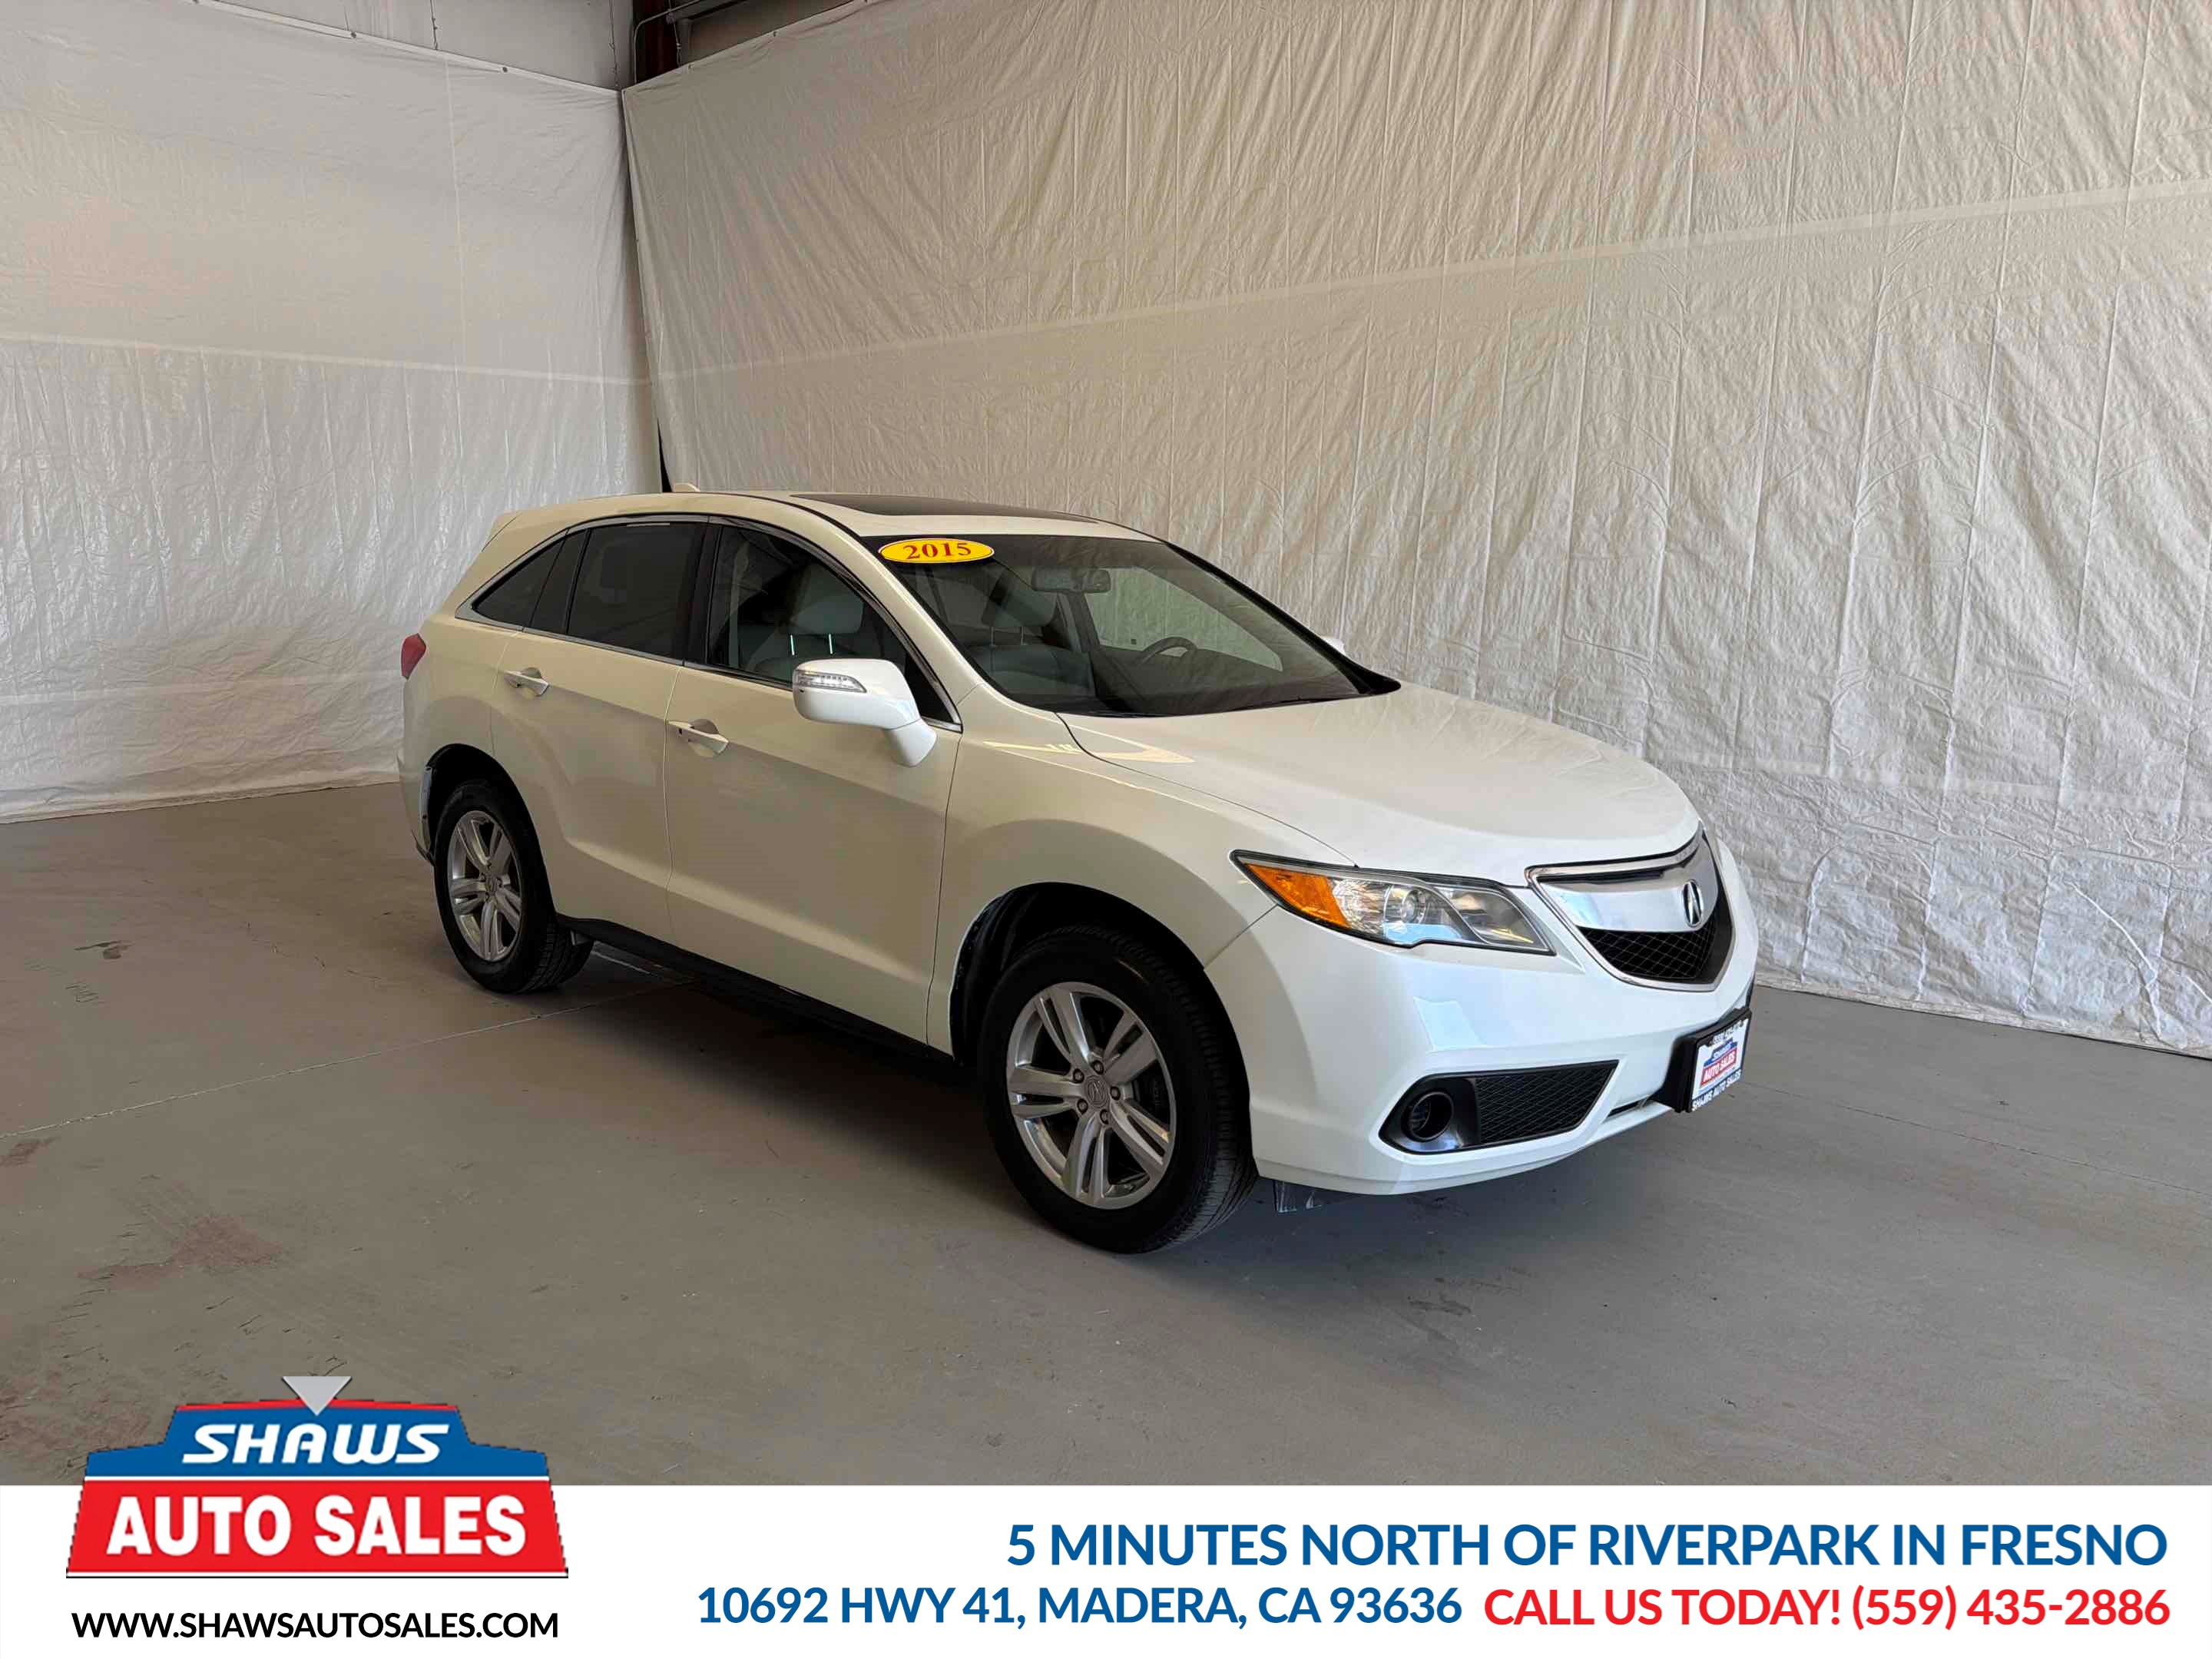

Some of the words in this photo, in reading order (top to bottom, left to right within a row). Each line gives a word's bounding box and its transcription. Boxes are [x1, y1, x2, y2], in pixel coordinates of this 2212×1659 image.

[902, 542, 972, 560] 2015
[1703, 1061, 1720, 1082] AUTO
[1720, 1051, 1736, 1071] SALES
